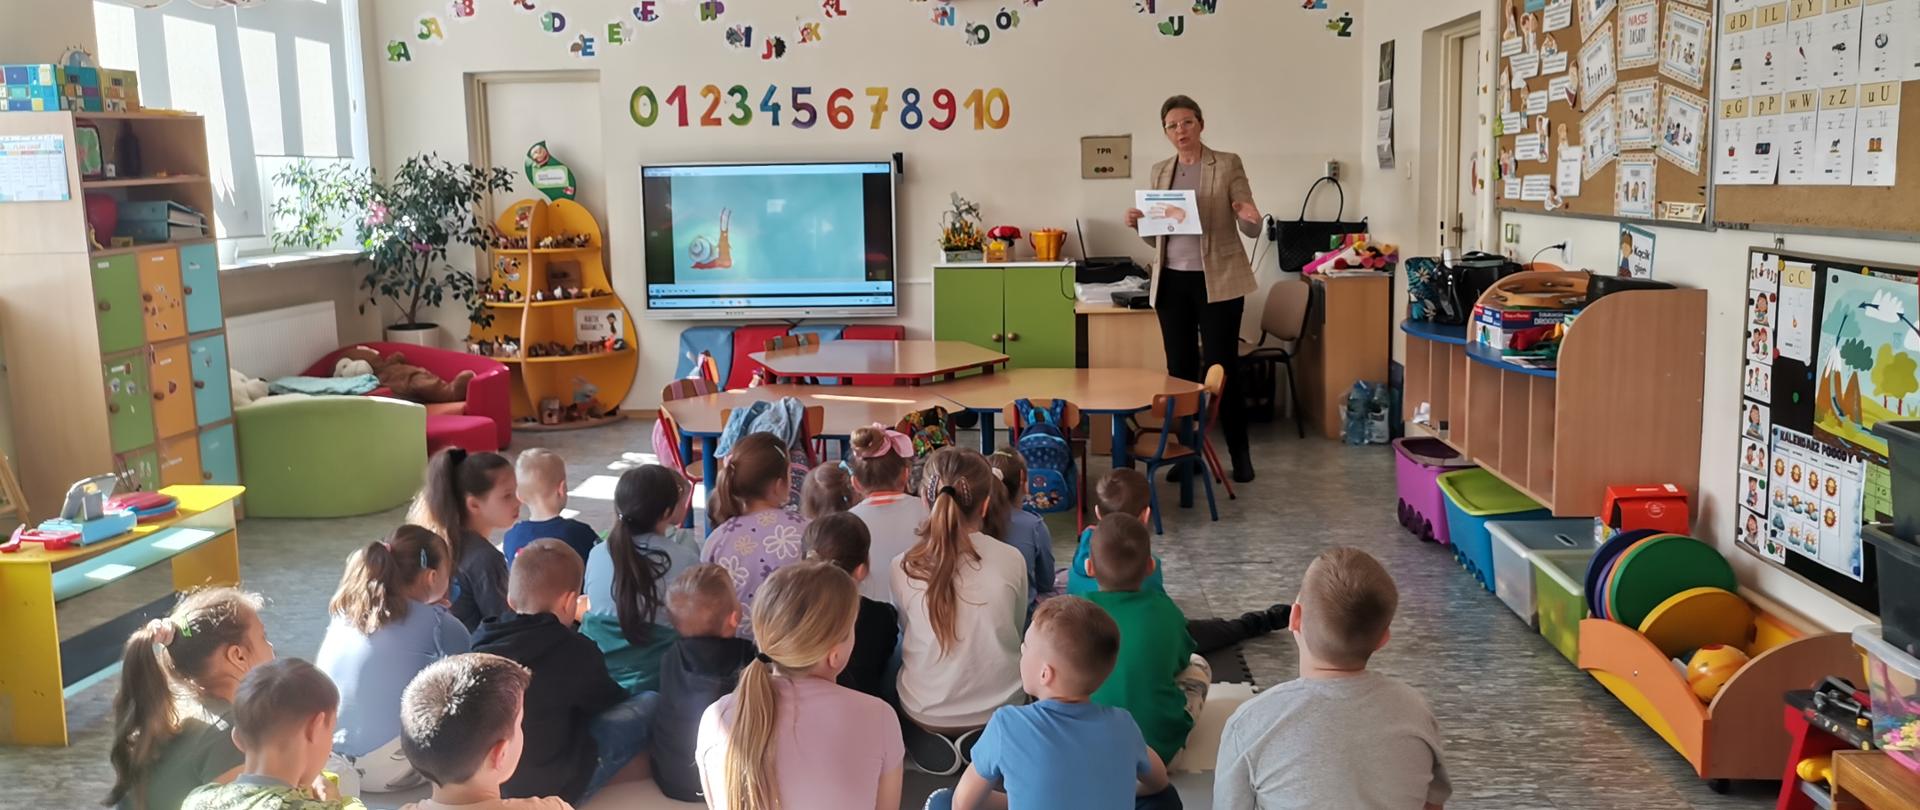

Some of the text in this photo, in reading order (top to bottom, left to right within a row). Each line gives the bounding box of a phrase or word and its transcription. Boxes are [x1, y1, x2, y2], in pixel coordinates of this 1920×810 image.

[641, 1, 655, 21] F
[996, 7, 1012, 30] Ó
[551, 12, 566, 32] D
[1168, 15, 1184, 36] U
[973, 24, 990, 44] O
[581, 38, 595, 56] E
[761, 39, 773, 59] J
[629, 84, 1010, 131] 0 1 2 3 4 5 6 7 8 9 10
[1780, 430, 1820, 454] KALENDARZ
